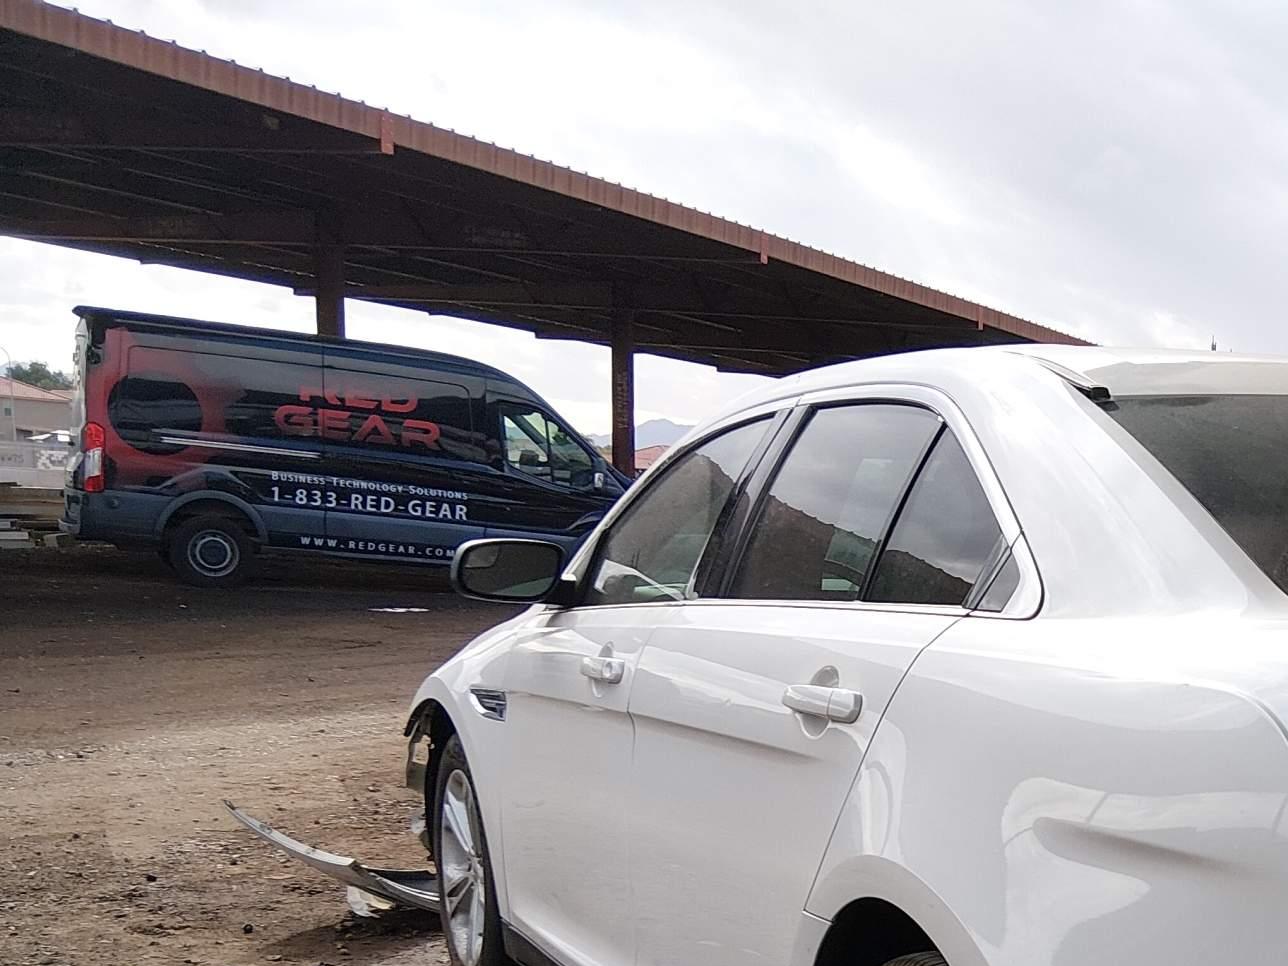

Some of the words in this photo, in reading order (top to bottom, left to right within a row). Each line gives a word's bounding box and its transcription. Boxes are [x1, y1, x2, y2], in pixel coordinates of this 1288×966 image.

[299, 380, 418, 413] RED
[273, 405, 441, 449] GEAR
[271, 486, 467, 520] 1-833-RED-GEAR
